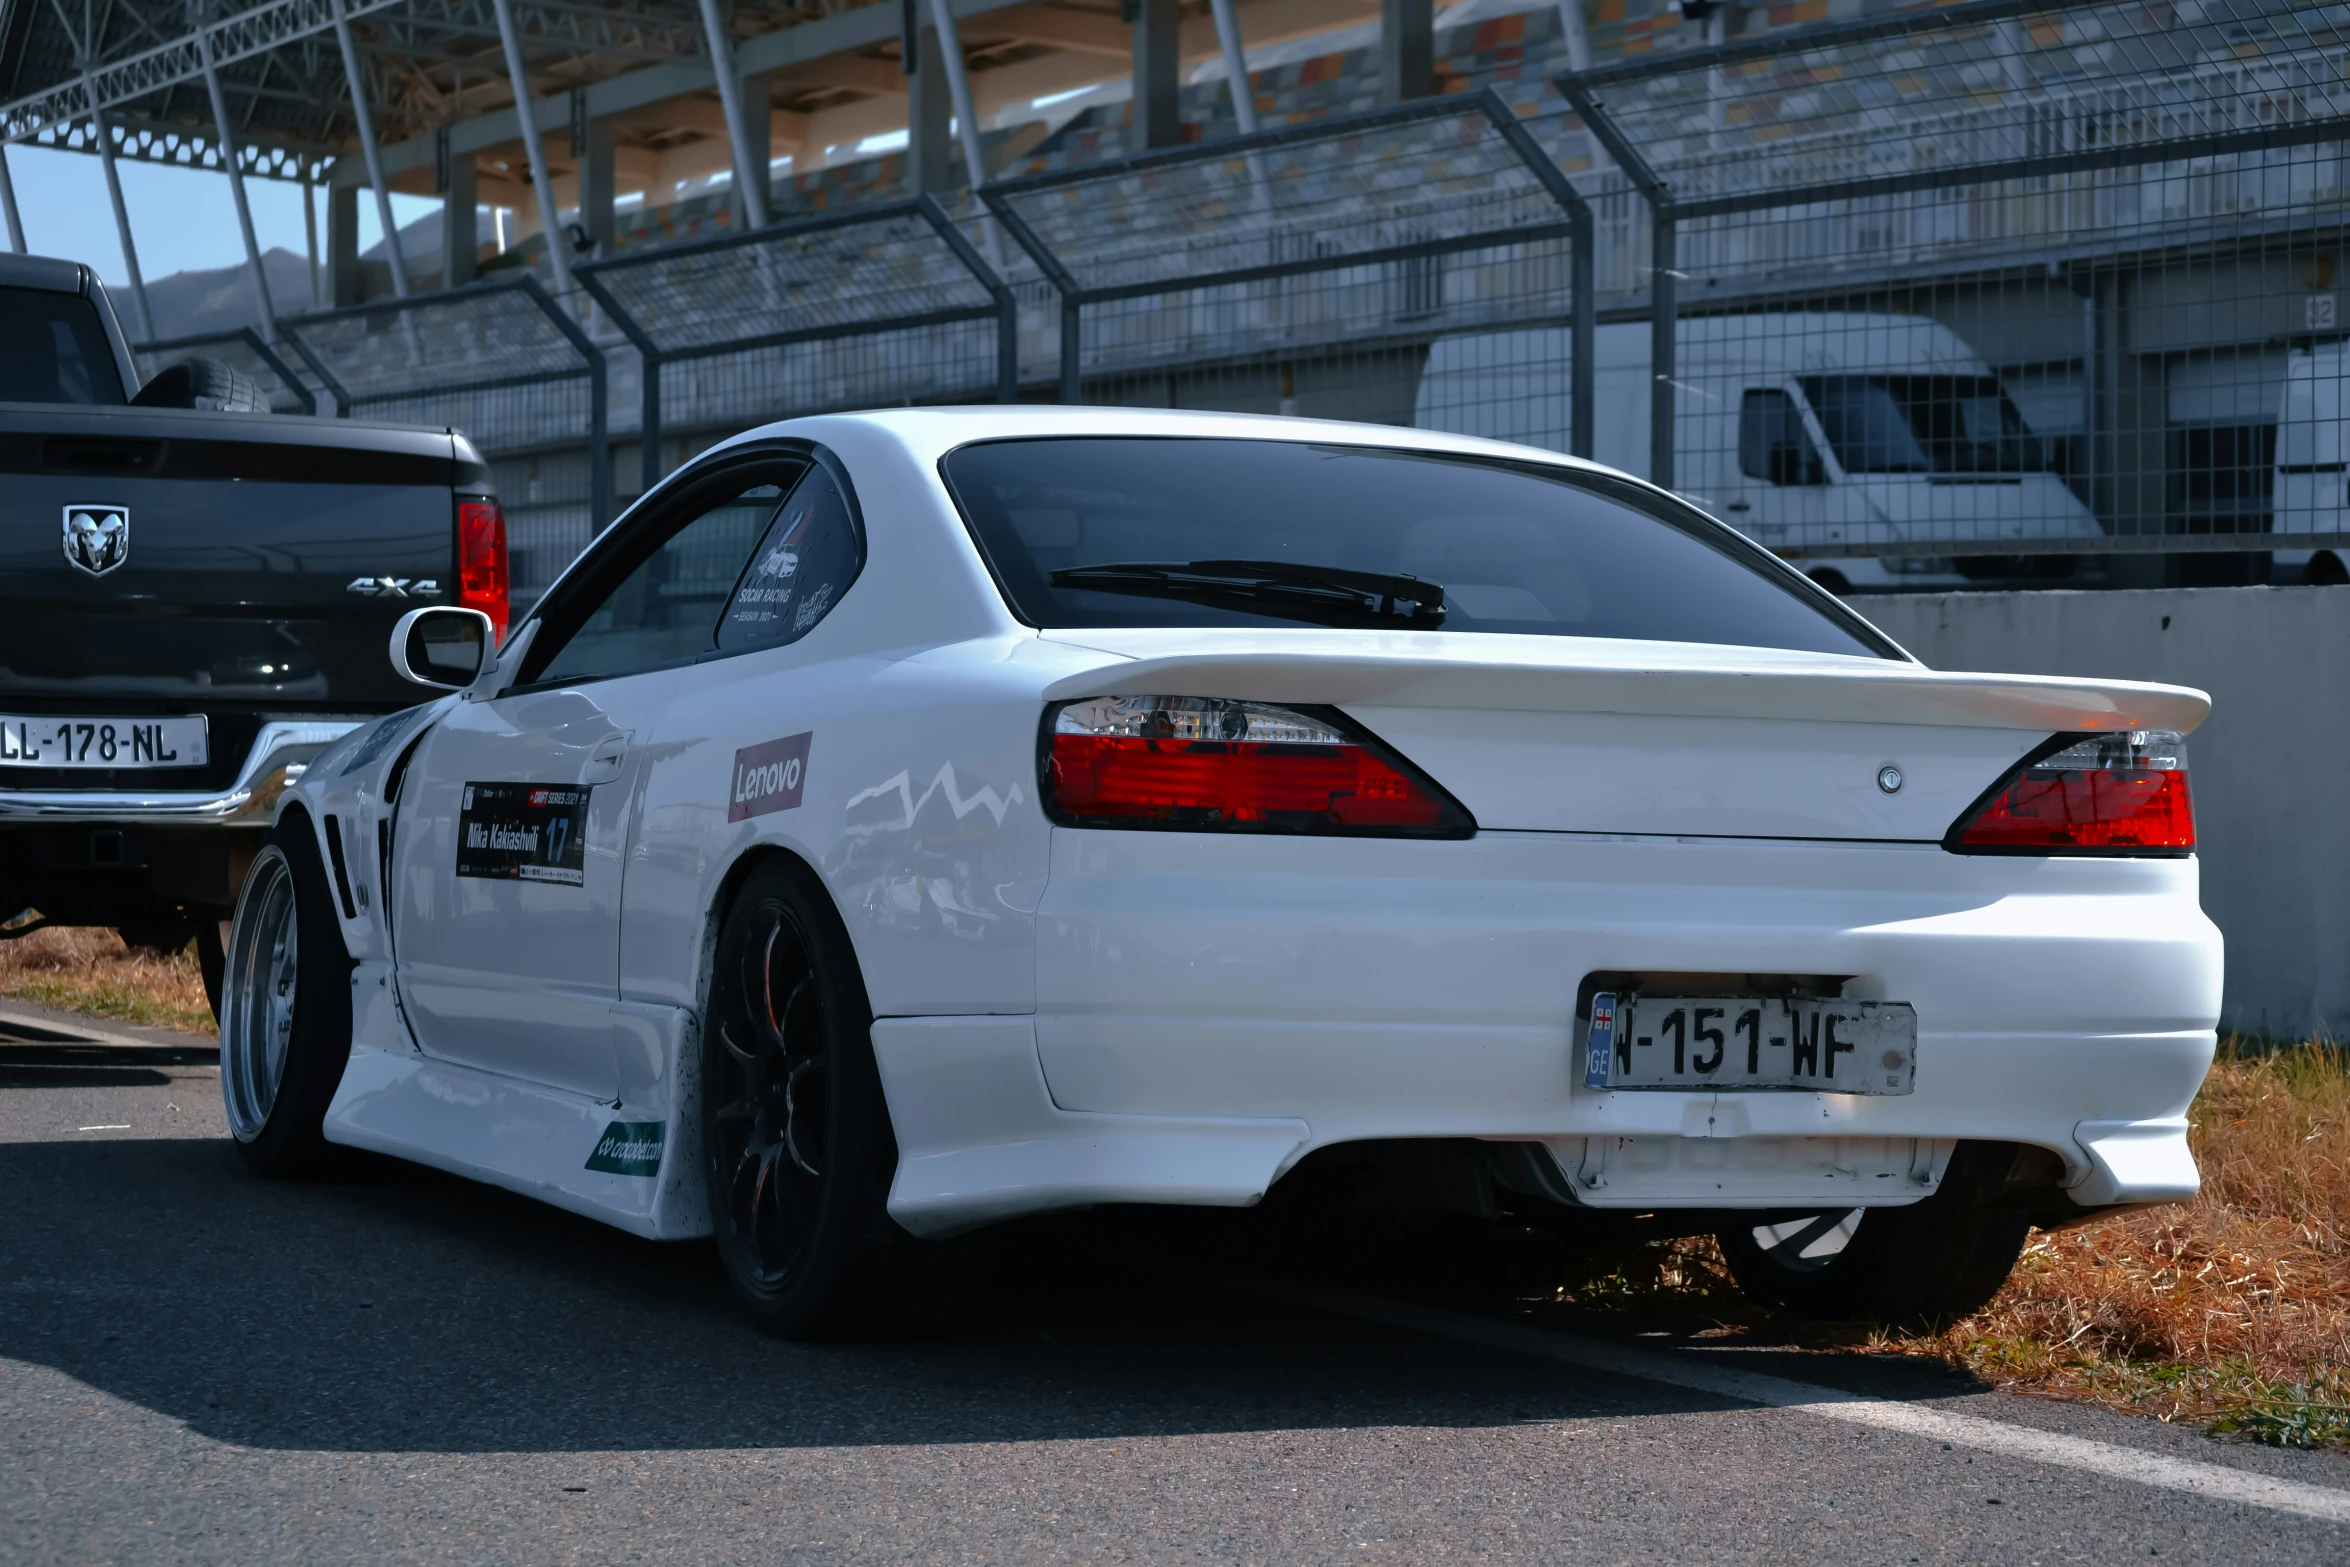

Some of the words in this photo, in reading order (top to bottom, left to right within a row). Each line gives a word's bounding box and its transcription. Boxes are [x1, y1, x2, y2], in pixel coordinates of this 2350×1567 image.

[738, 588, 764, 602] SOCAR
[762, 588, 792, 603] RACING
[738, 611, 759, 622] SEASON
[759, 611, 772, 622] 2021
[0, 721, 177, 762] LL-178-NL
[735, 757, 801, 803] Lenovo
[533, 791, 549, 804] DRIFT
[548, 792, 566, 805] SERIES
[565, 793, 579, 805] 2021
[467, 822, 489, 849] Nika
[489, 823, 540, 852] Kakiashvili
[546, 817, 569, 863] 17
[1590, 1049, 1609, 1075] GE
